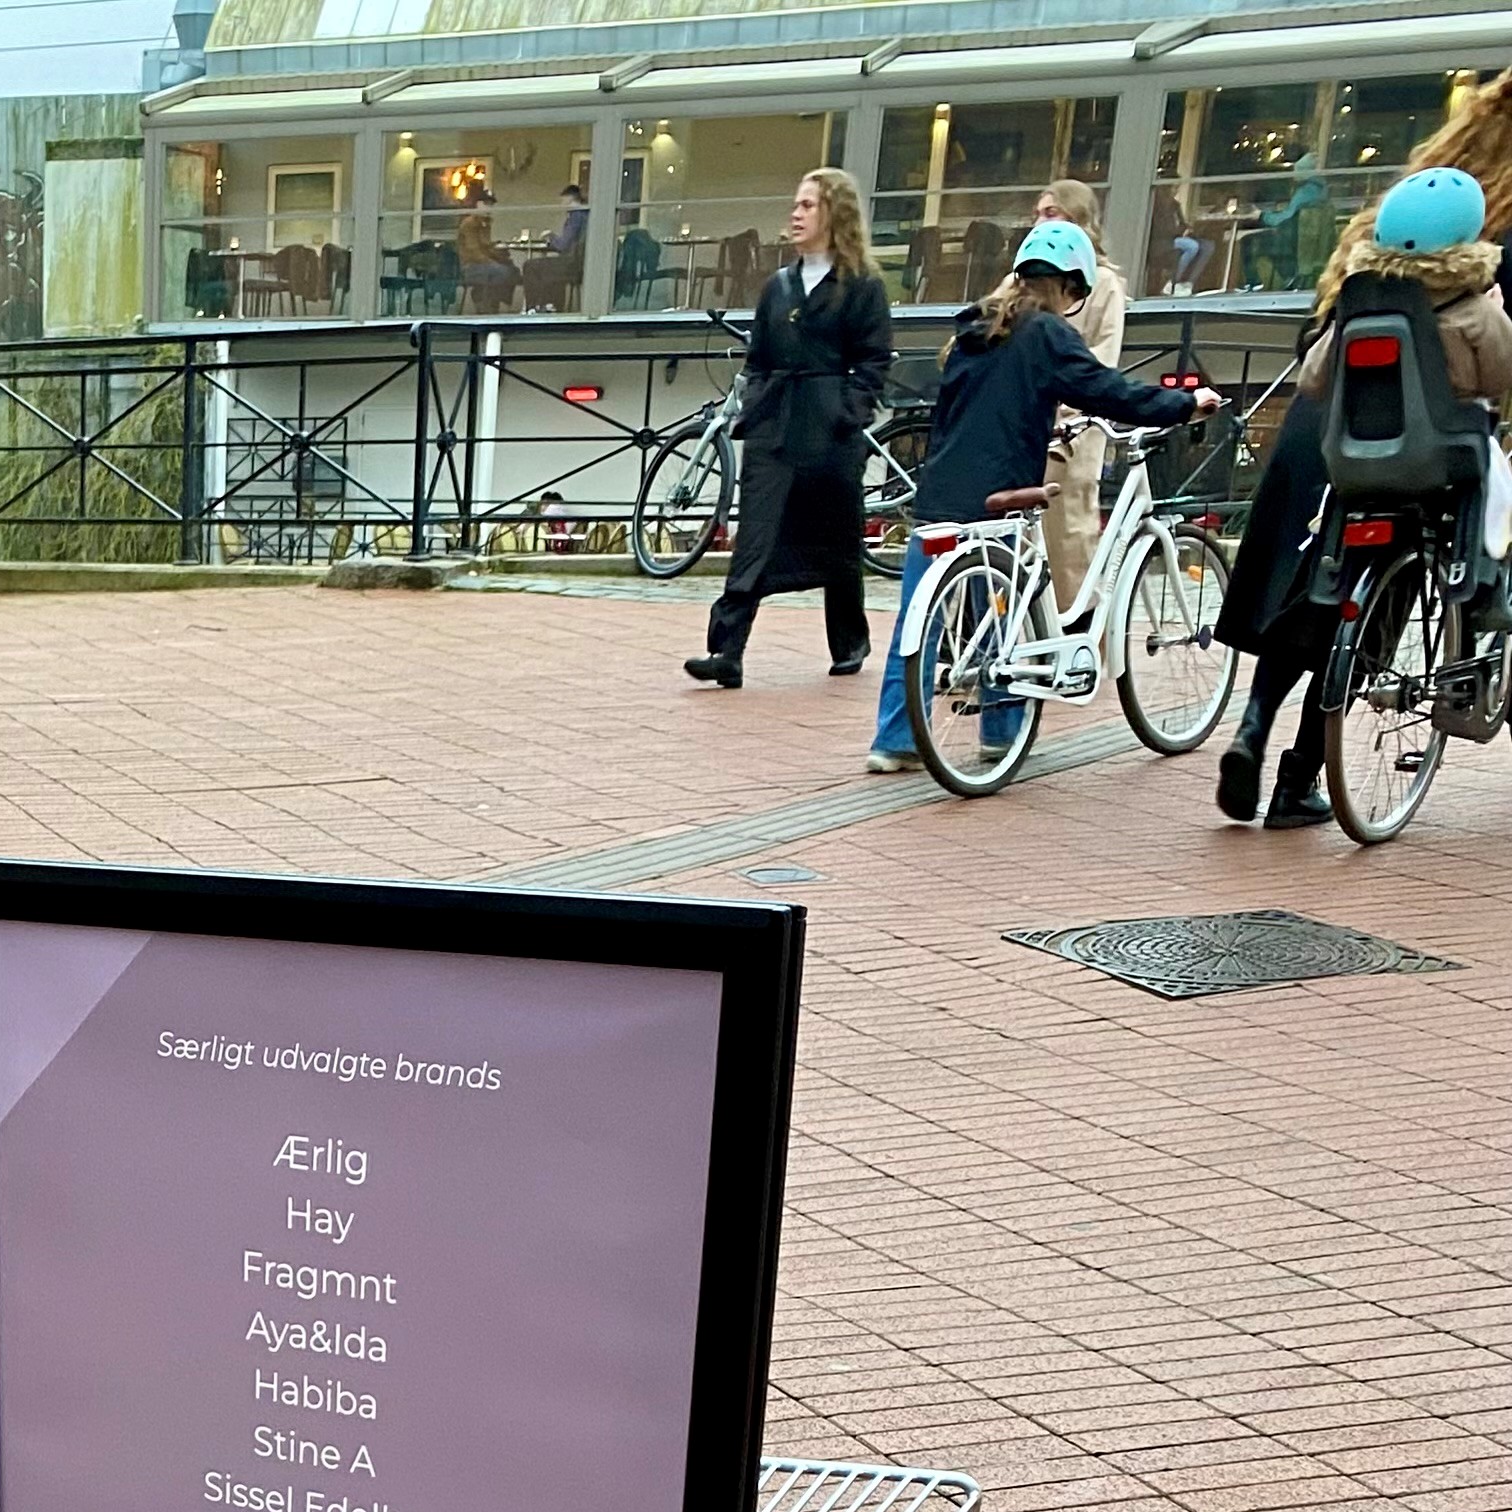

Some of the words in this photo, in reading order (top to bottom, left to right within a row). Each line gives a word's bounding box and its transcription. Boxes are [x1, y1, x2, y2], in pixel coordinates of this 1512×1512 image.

[156, 1031, 256, 1071] Særligt
[262, 1042, 387, 1083] udvalgte
[394, 1052, 502, 1091] brands
[272, 1135, 368, 1186] Ærlig
[287, 1196, 355, 1245] Hay
[243, 1250, 397, 1305] Fragmnt
[245, 1311, 387, 1363] Aya&Ida
[255, 1368, 377, 1420] Habiba
[253, 1425, 341, 1470] Stine
[349, 1444, 377, 1478] A
